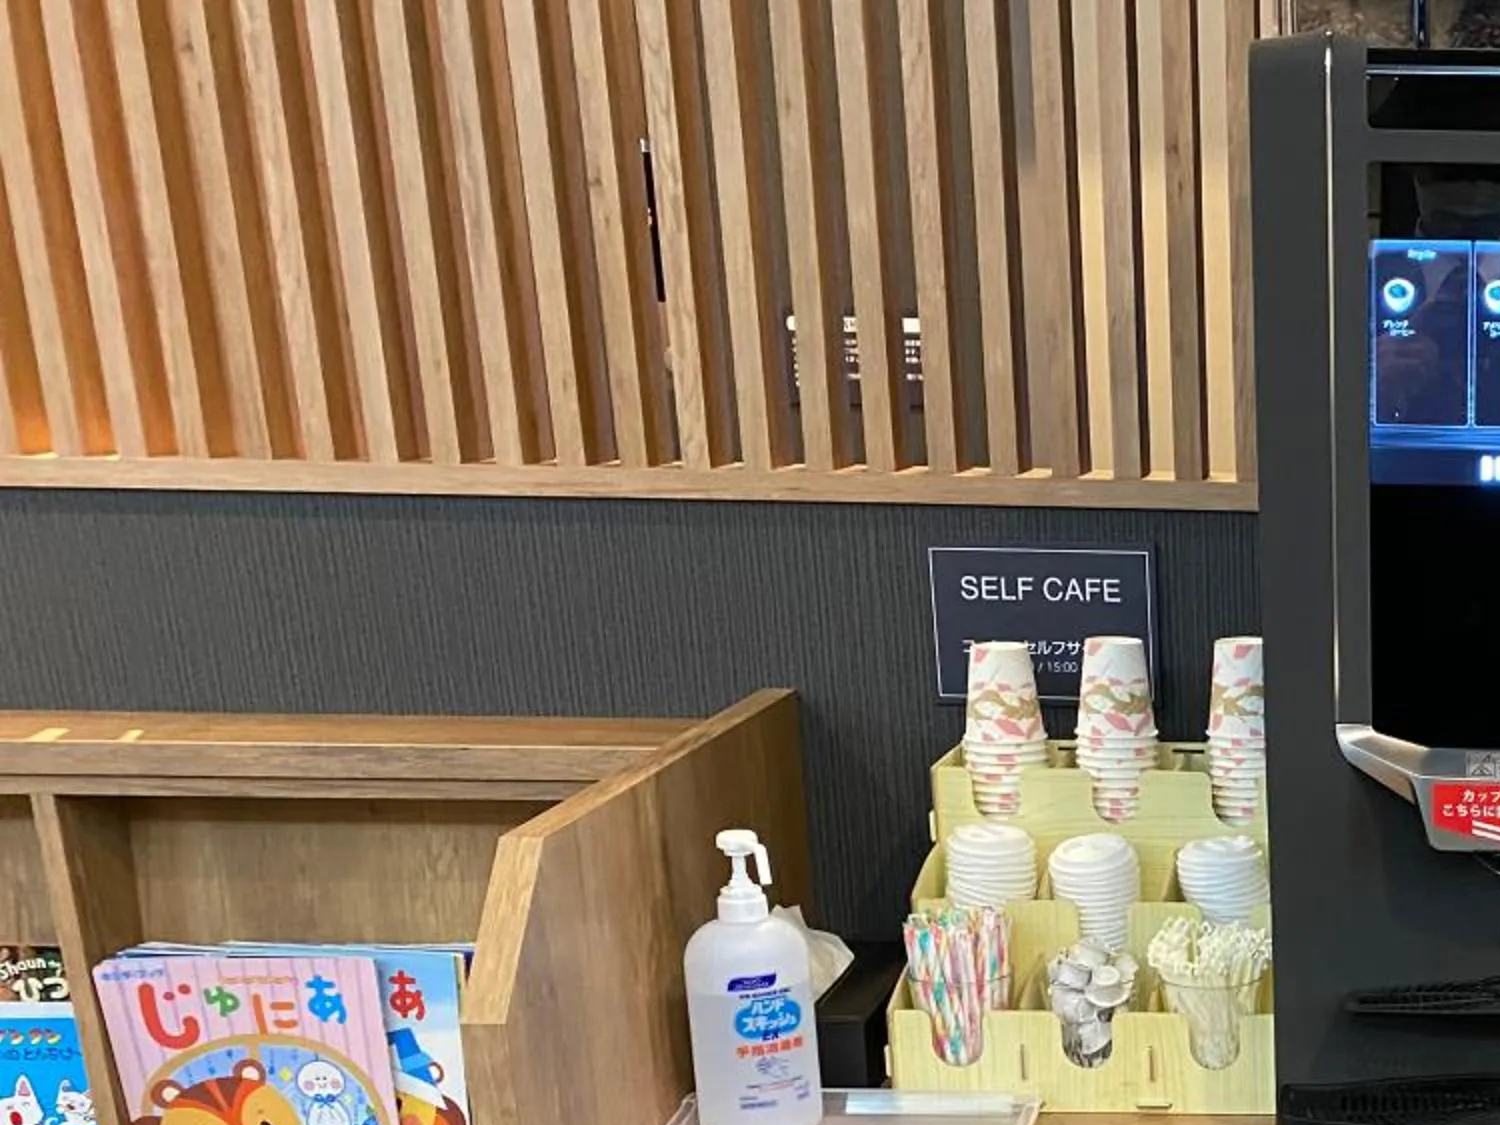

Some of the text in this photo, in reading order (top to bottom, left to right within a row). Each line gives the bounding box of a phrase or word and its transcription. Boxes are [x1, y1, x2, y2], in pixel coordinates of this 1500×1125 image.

[960, 575, 1122, 603] SELF CAFE
[1047, 661, 1079, 673] 15:00
[137, 974, 348, 1050] じゅにあ
